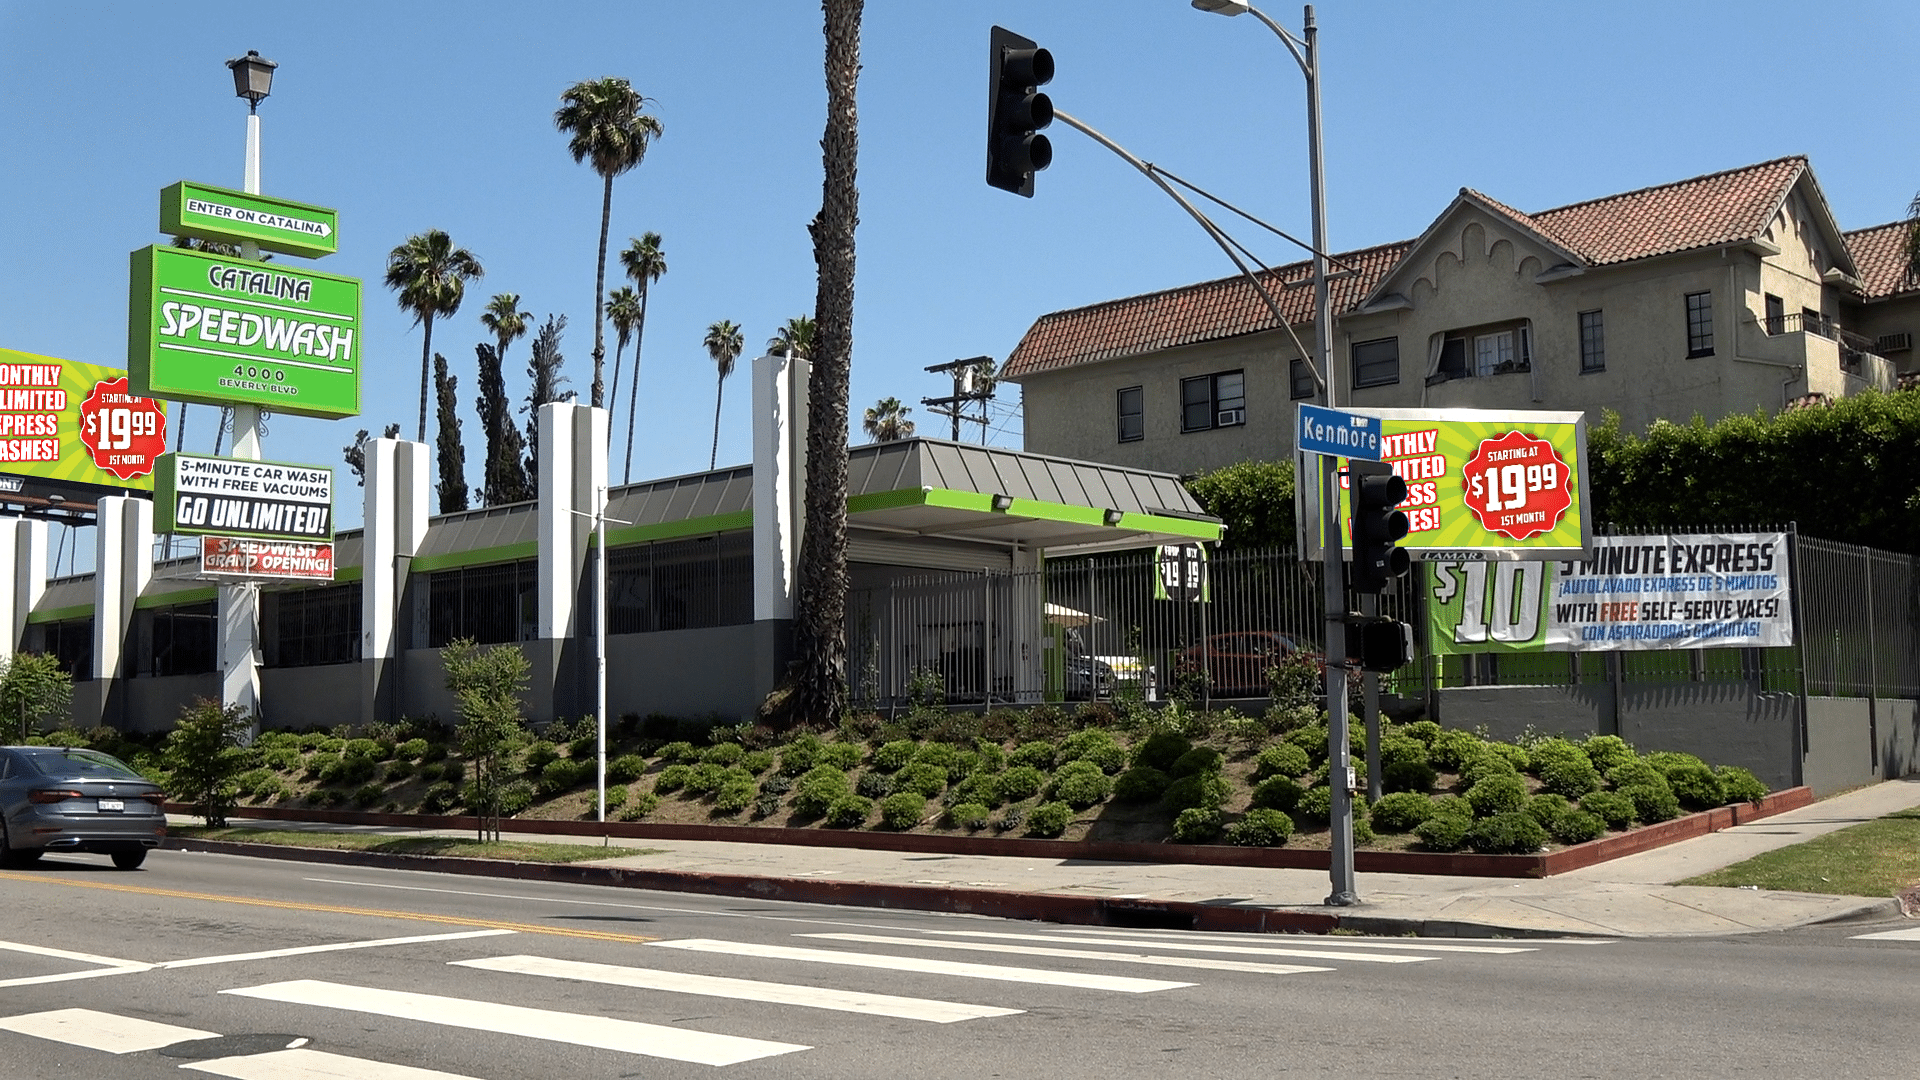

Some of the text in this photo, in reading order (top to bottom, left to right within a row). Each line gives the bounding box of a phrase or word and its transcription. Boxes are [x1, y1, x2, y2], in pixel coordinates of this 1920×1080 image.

[188, 200, 323, 235] ENTER ON CATALINA
[208, 265, 312, 302] CATALINA
[160, 301, 354, 362] SPEEDWASH
[0, 364, 61, 387] ONTHLY
[234, 365, 284, 381] 4000
[219, 378, 298, 395] BEVERLY BLVD
[0, 389, 66, 411] LIMITED
[0, 413, 58, 436] PRESS
[1304, 415, 1377, 450] Kenmore
[0, 438, 59, 461] ASHES!
[109, 454, 145, 465] 1ST MONTH
[1488, 446, 1538, 462] STARTING AT
[181, 461, 328, 484] 5-MINUTE CAR WASH
[180, 475, 328, 498] WITH FREE VACUUMS
[177, 496, 329, 535] GO UNLIMITED!
[1501, 511, 1545, 526] 1ST MONTH
[206, 553, 330, 571] GRAND OPENING!
[1424, 552, 1479, 560] LAMAR
[1580, 546, 1667, 576] MINUTE
[1670, 543, 1774, 574] EXPRESS
[1643, 576, 1696, 593] EXPRESS
[1699, 576, 1712, 591] DE
[1715, 576, 1722, 590] 5
[1725, 574, 1778, 591] MINUTOS
[1433, 561, 1545, 643] $10
[1556, 599, 1780, 623] WITH FREE SELF-SERVE VACS!
[1582, 622, 1760, 641] CON ASPIRADORAS GRATUITAS!
